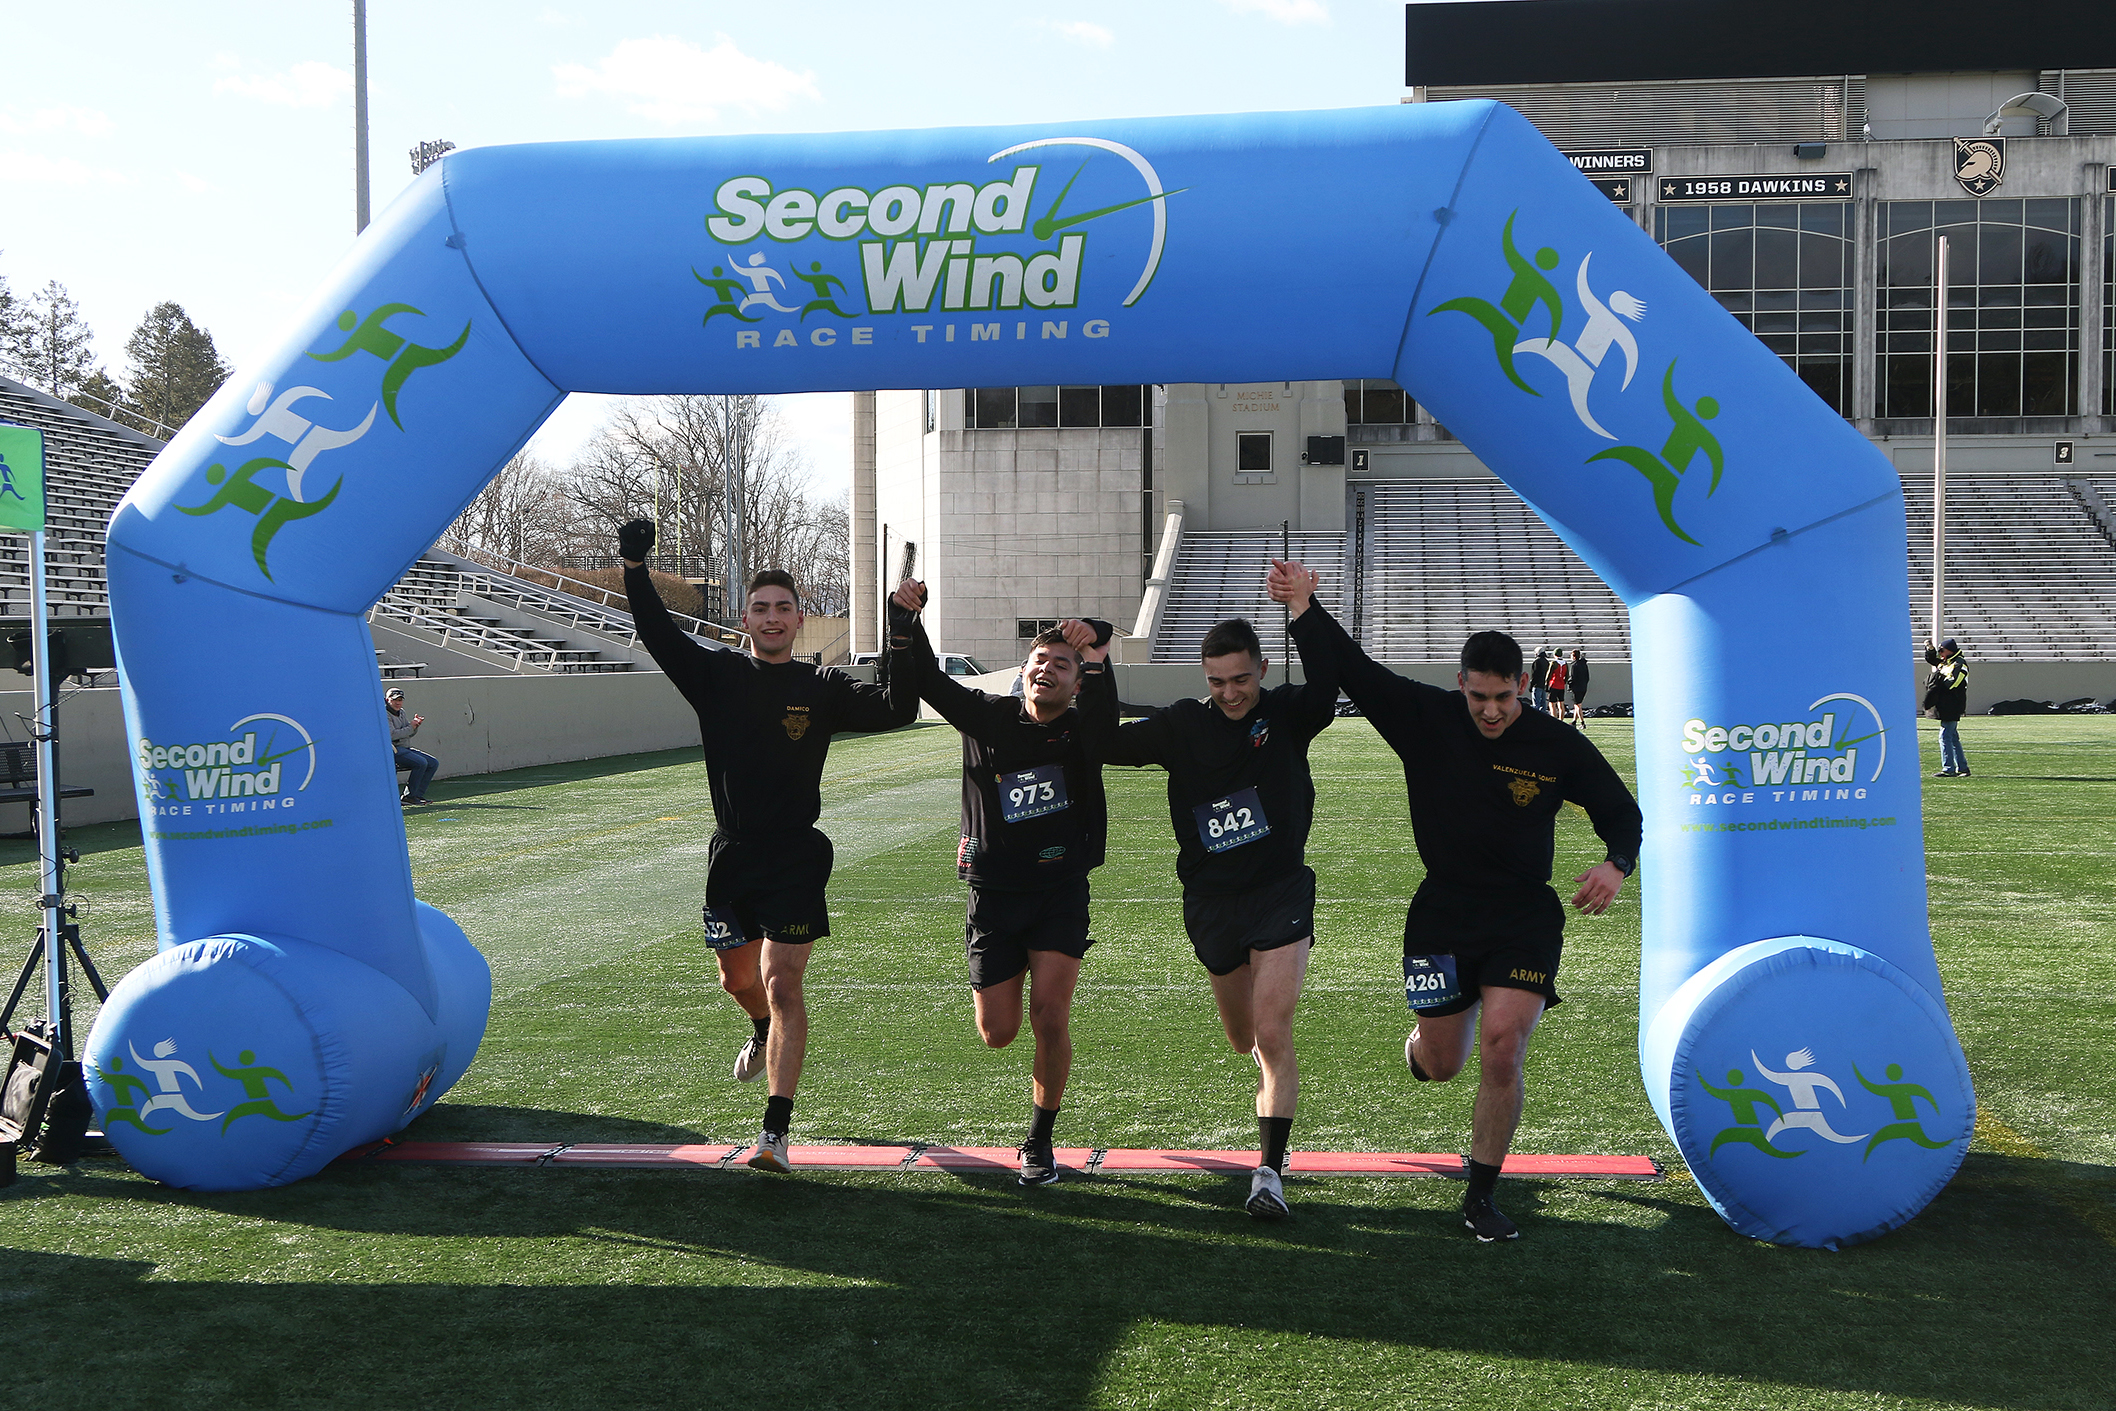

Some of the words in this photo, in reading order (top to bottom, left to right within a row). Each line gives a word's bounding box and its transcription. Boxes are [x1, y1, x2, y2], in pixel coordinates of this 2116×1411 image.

[1569, 154, 1645, 169] WINNERS
[1685, 182, 1732, 195] 1958
[1738, 179, 1826, 193] DAWKINS
[704, 164, 1042, 245] Second
[858, 231, 1088, 314] Wind
[736, 327, 874, 349] RACE
[911, 319, 1112, 343] TIMING
[1237, 391, 1273, 400] MICHIE
[1232, 402, 1280, 412] STADIUM
[1356, 454, 1365, 466] 1
[2059, 446, 2069, 459] 3
[1681, 712, 1835, 754] Second
[139, 732, 256, 770] Second
[1492, 764, 1536, 778] VALENZUELA
[1749, 748, 1857, 787] Wind
[184, 761, 282, 800] Wind
[1009, 780, 1055, 808] 973
[1689, 792, 1755, 805] RACE
[1772, 788, 1868, 803] TIMING
[205, 797, 295, 814] TIMING
[1207, 807, 1256, 838] 842
[1680, 815, 1897, 833] www.secondwindtiming.com
[1404, 972, 1447, 992] 4261
[1509, 968, 1547, 985] ARMY
